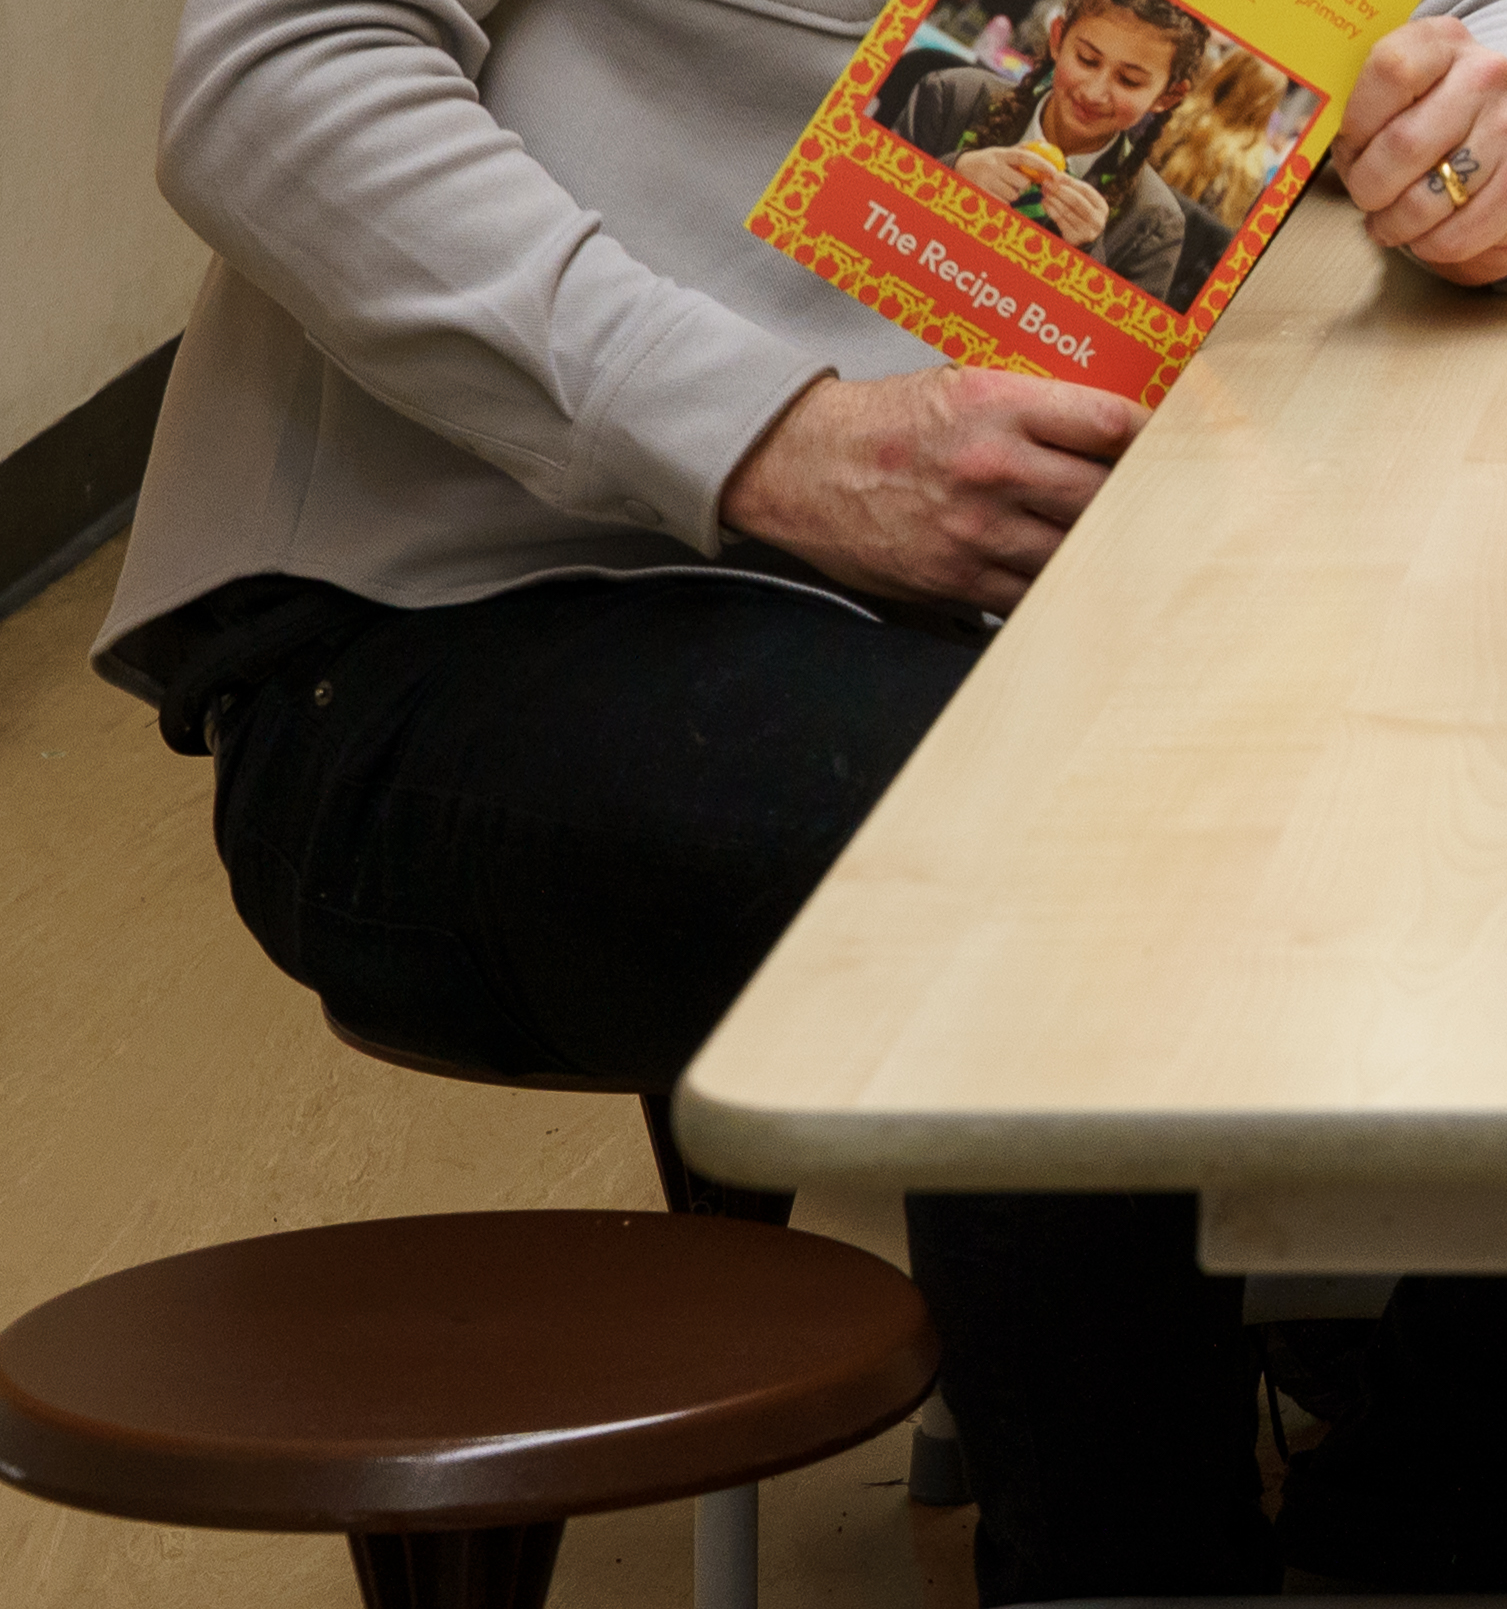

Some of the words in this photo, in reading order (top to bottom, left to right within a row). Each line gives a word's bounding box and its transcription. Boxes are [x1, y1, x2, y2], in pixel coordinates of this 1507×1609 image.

[862, 200, 917, 255] The
[918, 239, 1017, 318] Recipe
[1017, 302, 1096, 368] Book
